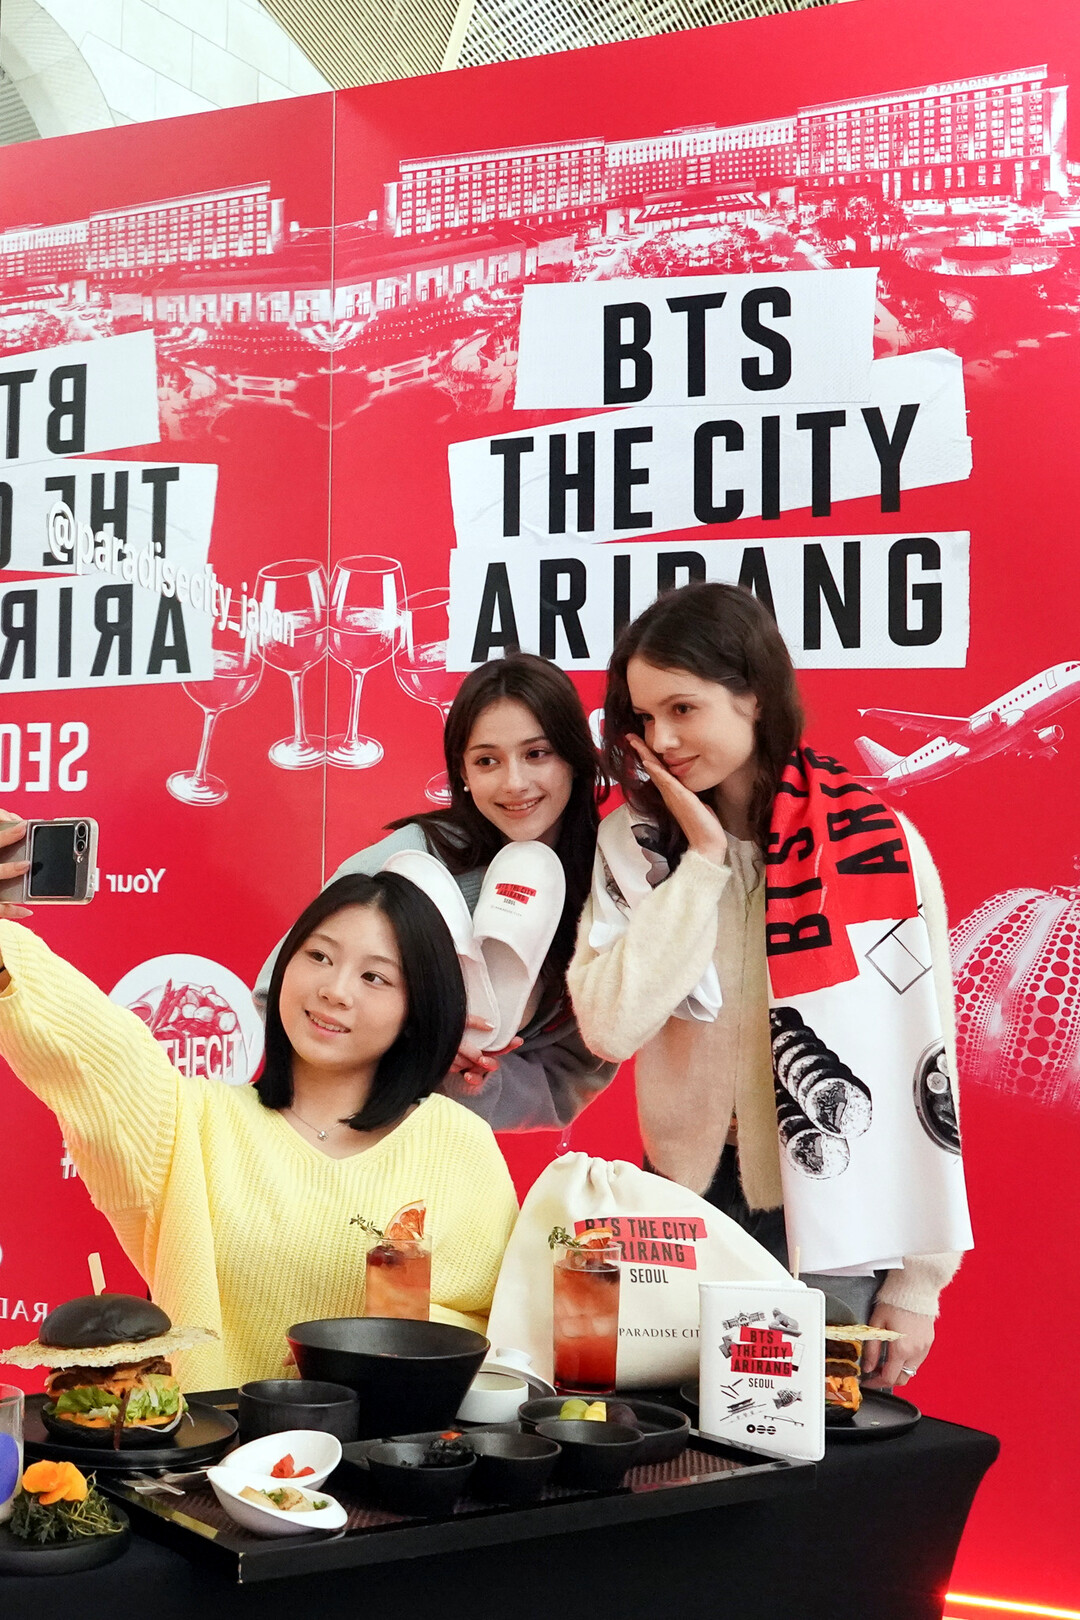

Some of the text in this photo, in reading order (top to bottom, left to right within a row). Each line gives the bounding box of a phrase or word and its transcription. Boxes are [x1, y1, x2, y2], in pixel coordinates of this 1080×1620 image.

[940, 70, 1025, 93] PARADISE CITY
[603, 286, 792, 405] BTS
[490, 404, 920, 538] THE CITY
[48, 500, 296, 648] @paradisecity_japan
[627, 1218, 658, 1239] THE
[662, 1221, 697, 1242] CITY
[630, 1268, 669, 1284] SEOUL
[619, 1327, 678, 1338] PARADISE
[750, 1330, 774, 1344] BTS
[736, 1344, 788, 1360] THE CITY
[733, 1360, 791, 1375] ARIRANG
[748, 1377, 775, 1390] SEOUL
